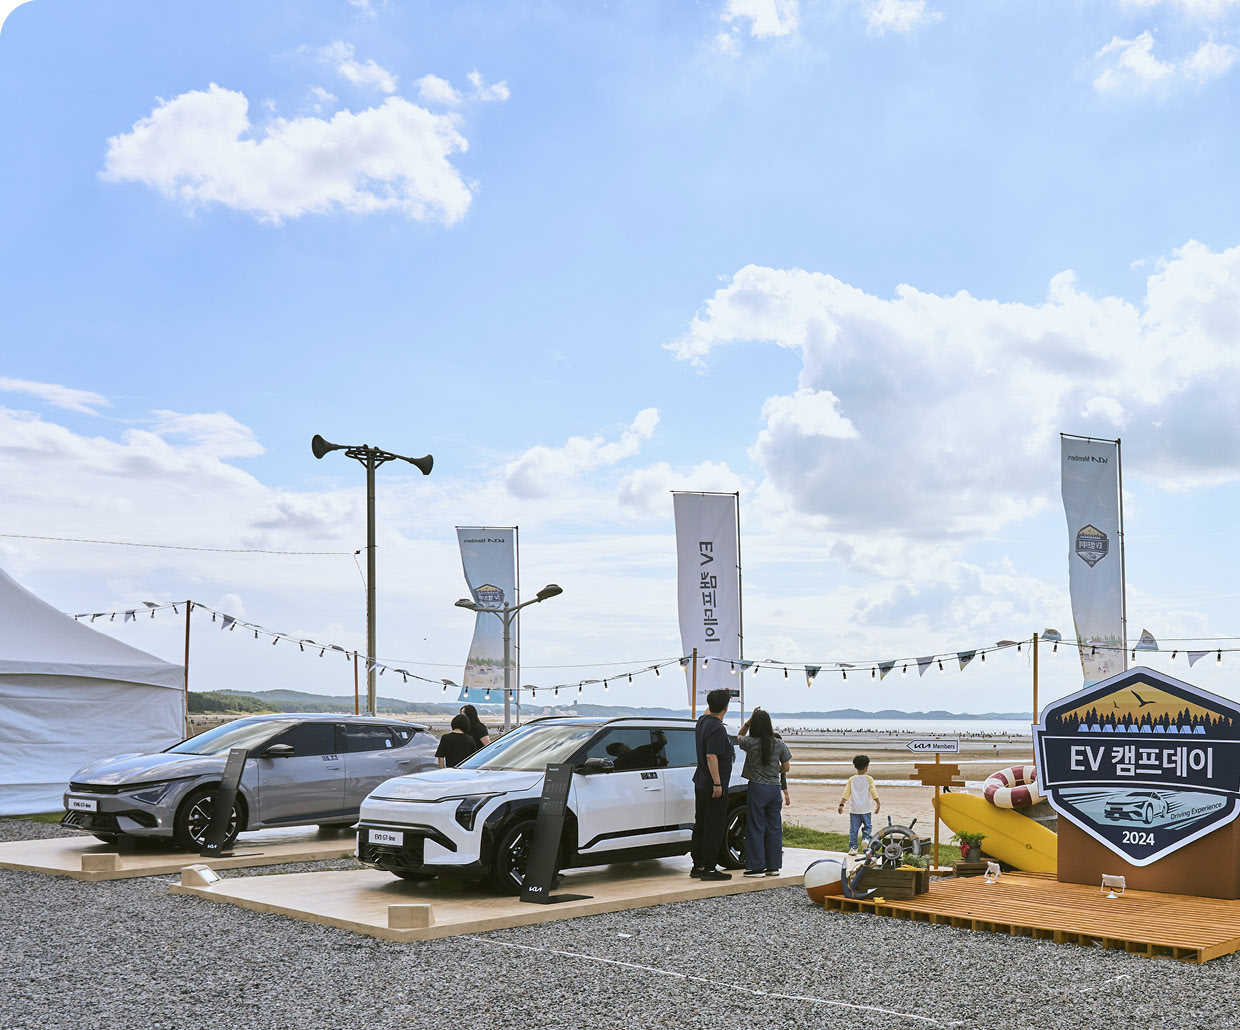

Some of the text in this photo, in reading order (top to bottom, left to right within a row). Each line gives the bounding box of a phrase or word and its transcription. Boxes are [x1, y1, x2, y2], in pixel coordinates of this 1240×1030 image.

[1070, 745, 1213, 779] EV 캠프데이
[1170, 802, 1222, 820] Driving Experience
[1122, 830, 1155, 846] 2024
